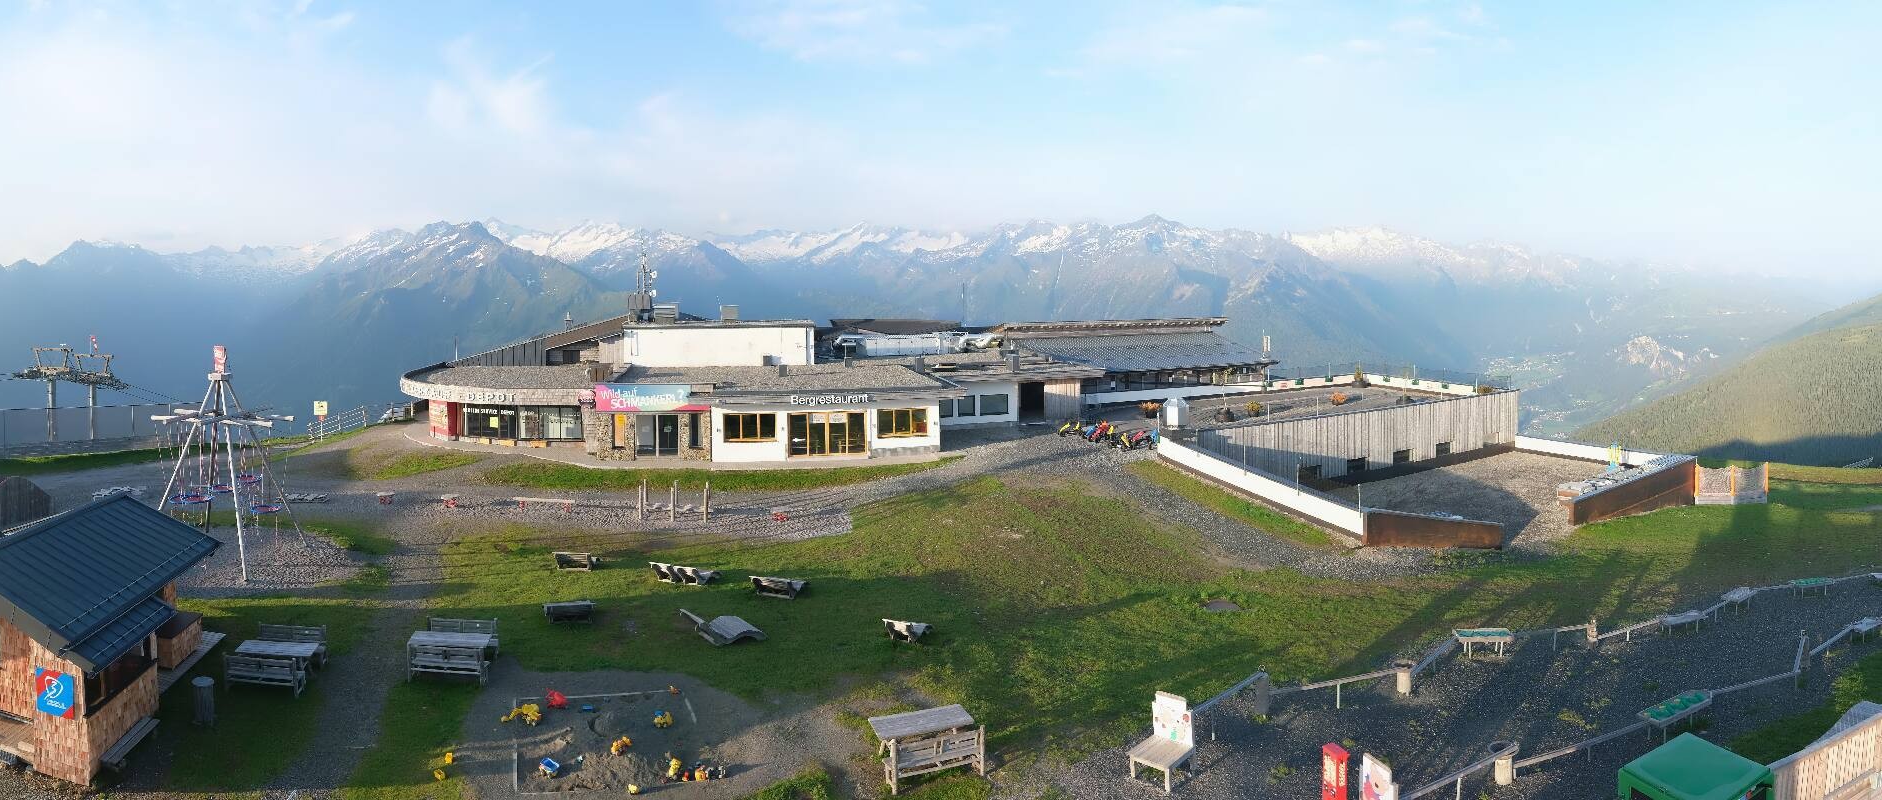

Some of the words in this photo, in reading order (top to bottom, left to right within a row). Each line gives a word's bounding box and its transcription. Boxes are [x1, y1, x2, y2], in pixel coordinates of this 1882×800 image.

[601, 388, 621, 399] Wild
[622, 387, 638, 398] auf
[790, 394, 868, 406] Bergrestaurant
